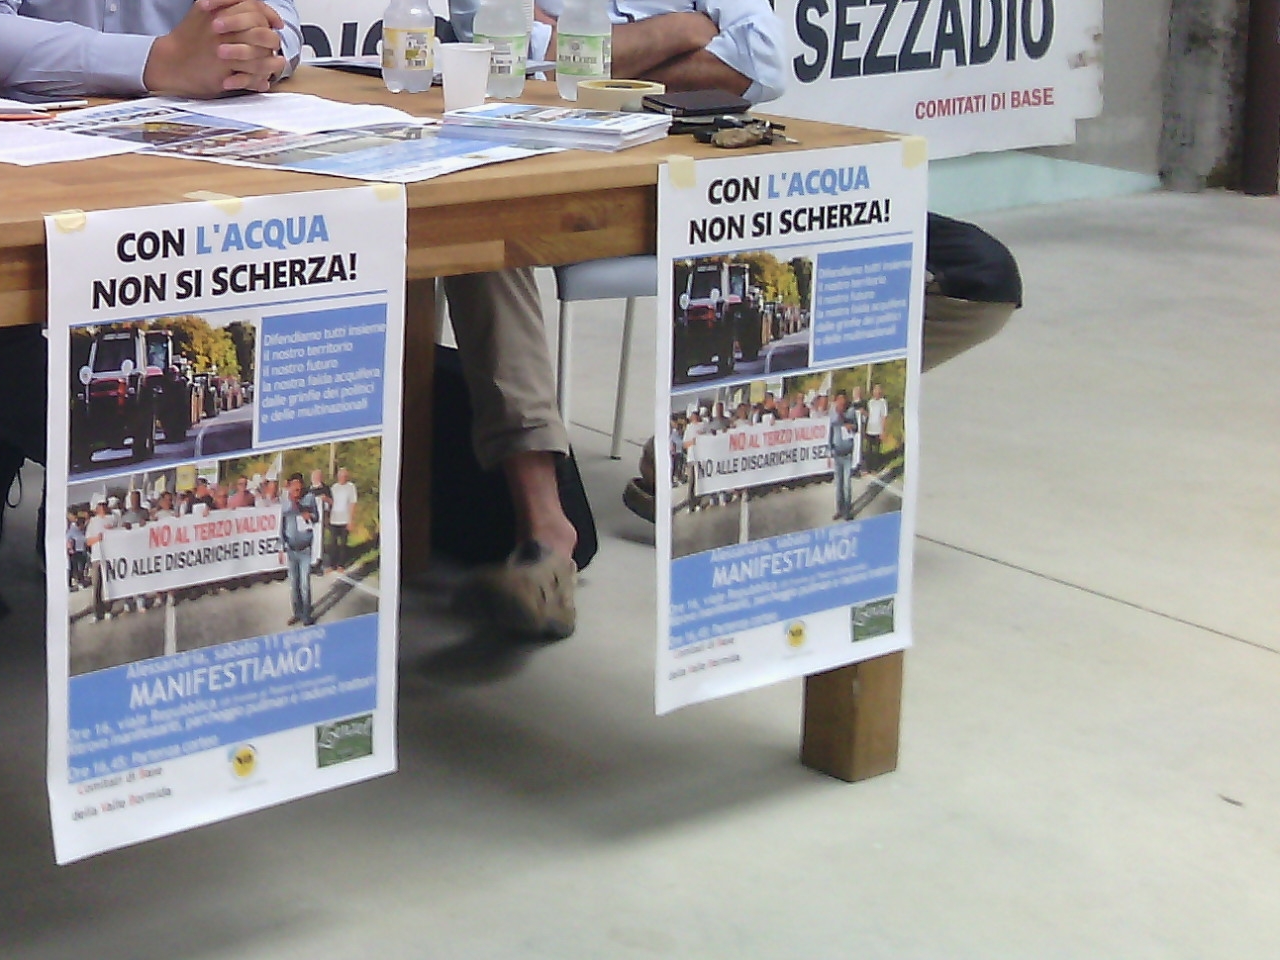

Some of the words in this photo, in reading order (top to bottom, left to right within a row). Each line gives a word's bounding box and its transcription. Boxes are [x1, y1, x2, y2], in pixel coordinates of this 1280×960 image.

[915, 94, 986, 120] COMITATI
[991, 92, 1005, 111] DI
[1011, 87, 1054, 108] BASE
[708, 176, 760, 205] CON
[767, 165, 870, 199] L'ACQUA
[117, 228, 184, 262] CON
[196, 214, 329, 254] L'ACQUA
[689, 214, 745, 245] NON
[752, 211, 771, 237] SI
[779, 199, 891, 235] SCHERZA!
[92, 273, 166, 310] NON
[175, 269, 201, 299] SI
[212, 253, 357, 296] SCHERZA!
[697, 459, 713, 479] NO
[741, 448, 798, 471] DISCARICHE
[800, 446, 809, 461] DI
[729, 432, 746, 452] NO
[149, 524, 172, 549] NO
[175, 526, 190, 544] AL
[194, 519, 232, 541] TERZO
[235, 514, 276, 534] VALICO
[105, 558, 127, 582] NO
[131, 555, 162, 576] ALLE
[165, 542, 240, 571] DISCARICHE
[243, 540, 254, 556] DI
[712, 538, 858, 589] MANIFESTIAMO!
[130, 644, 321, 710] MANIFESTIAMO!
